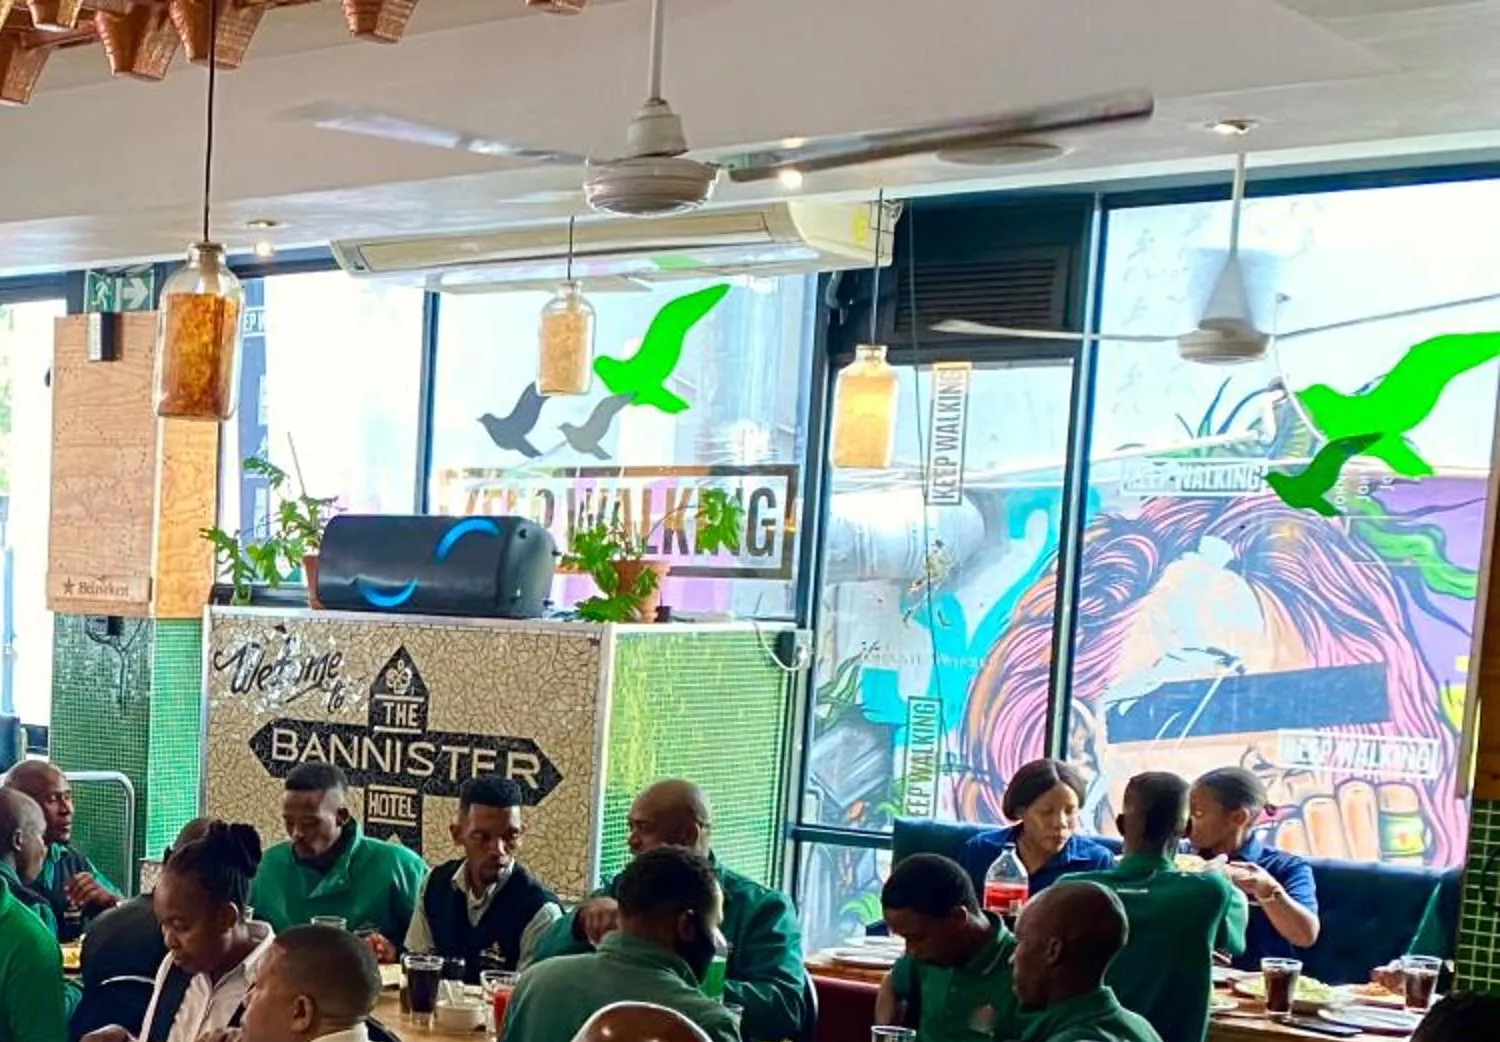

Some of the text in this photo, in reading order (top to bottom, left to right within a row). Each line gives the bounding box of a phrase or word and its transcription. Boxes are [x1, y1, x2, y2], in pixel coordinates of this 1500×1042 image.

[931, 371, 965, 500] KEEP WALKING
[1180, 465, 1262, 492] WALKING
[382, 701, 419, 728] THE
[271, 728, 541, 789] BANNISTER
[906, 702, 937, 817] EEP WALKING
[367, 791, 417, 819] HOTEL
